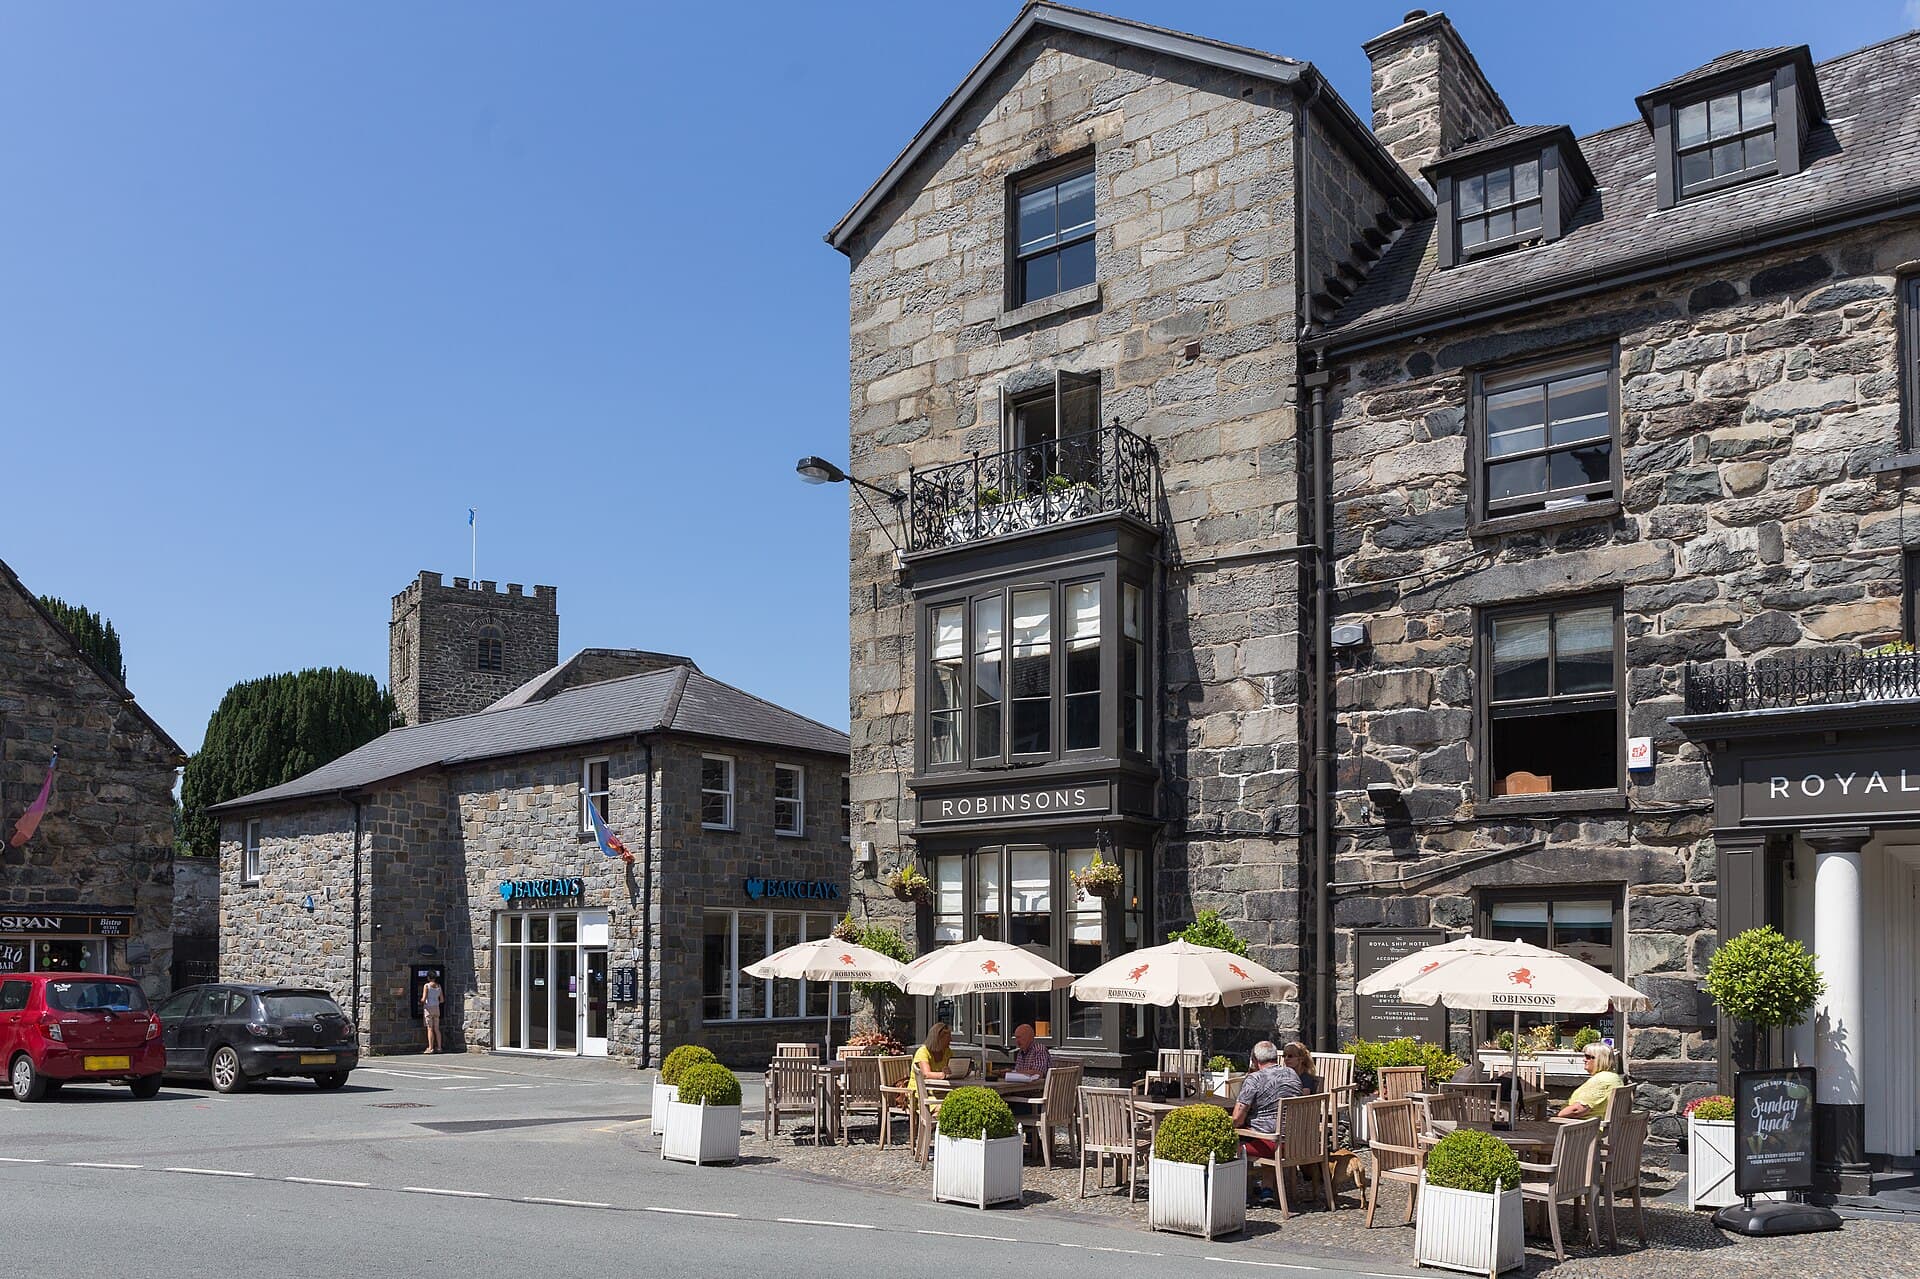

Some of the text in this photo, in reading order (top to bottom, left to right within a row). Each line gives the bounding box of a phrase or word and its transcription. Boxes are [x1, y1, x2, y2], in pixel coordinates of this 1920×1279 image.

[1769, 768, 1920, 799] ROYAL
[942, 789, 1086, 817] ROBINSONS
[514, 878, 580, 898] BARCLAYS
[767, 879, 841, 900] BARCLAYS
[0, 916, 62, 929] SPAN
[100, 918, 122, 926] Bistro
[834, 969, 873, 978] ROBINSONS
[973, 980, 1018, 989] ROBINSONS
[1108, 989, 1147, 999] ROBINSONS
[1492, 994, 1556, 1005] ROBINSONS
[1751, 1095, 1799, 1120] Sunday
